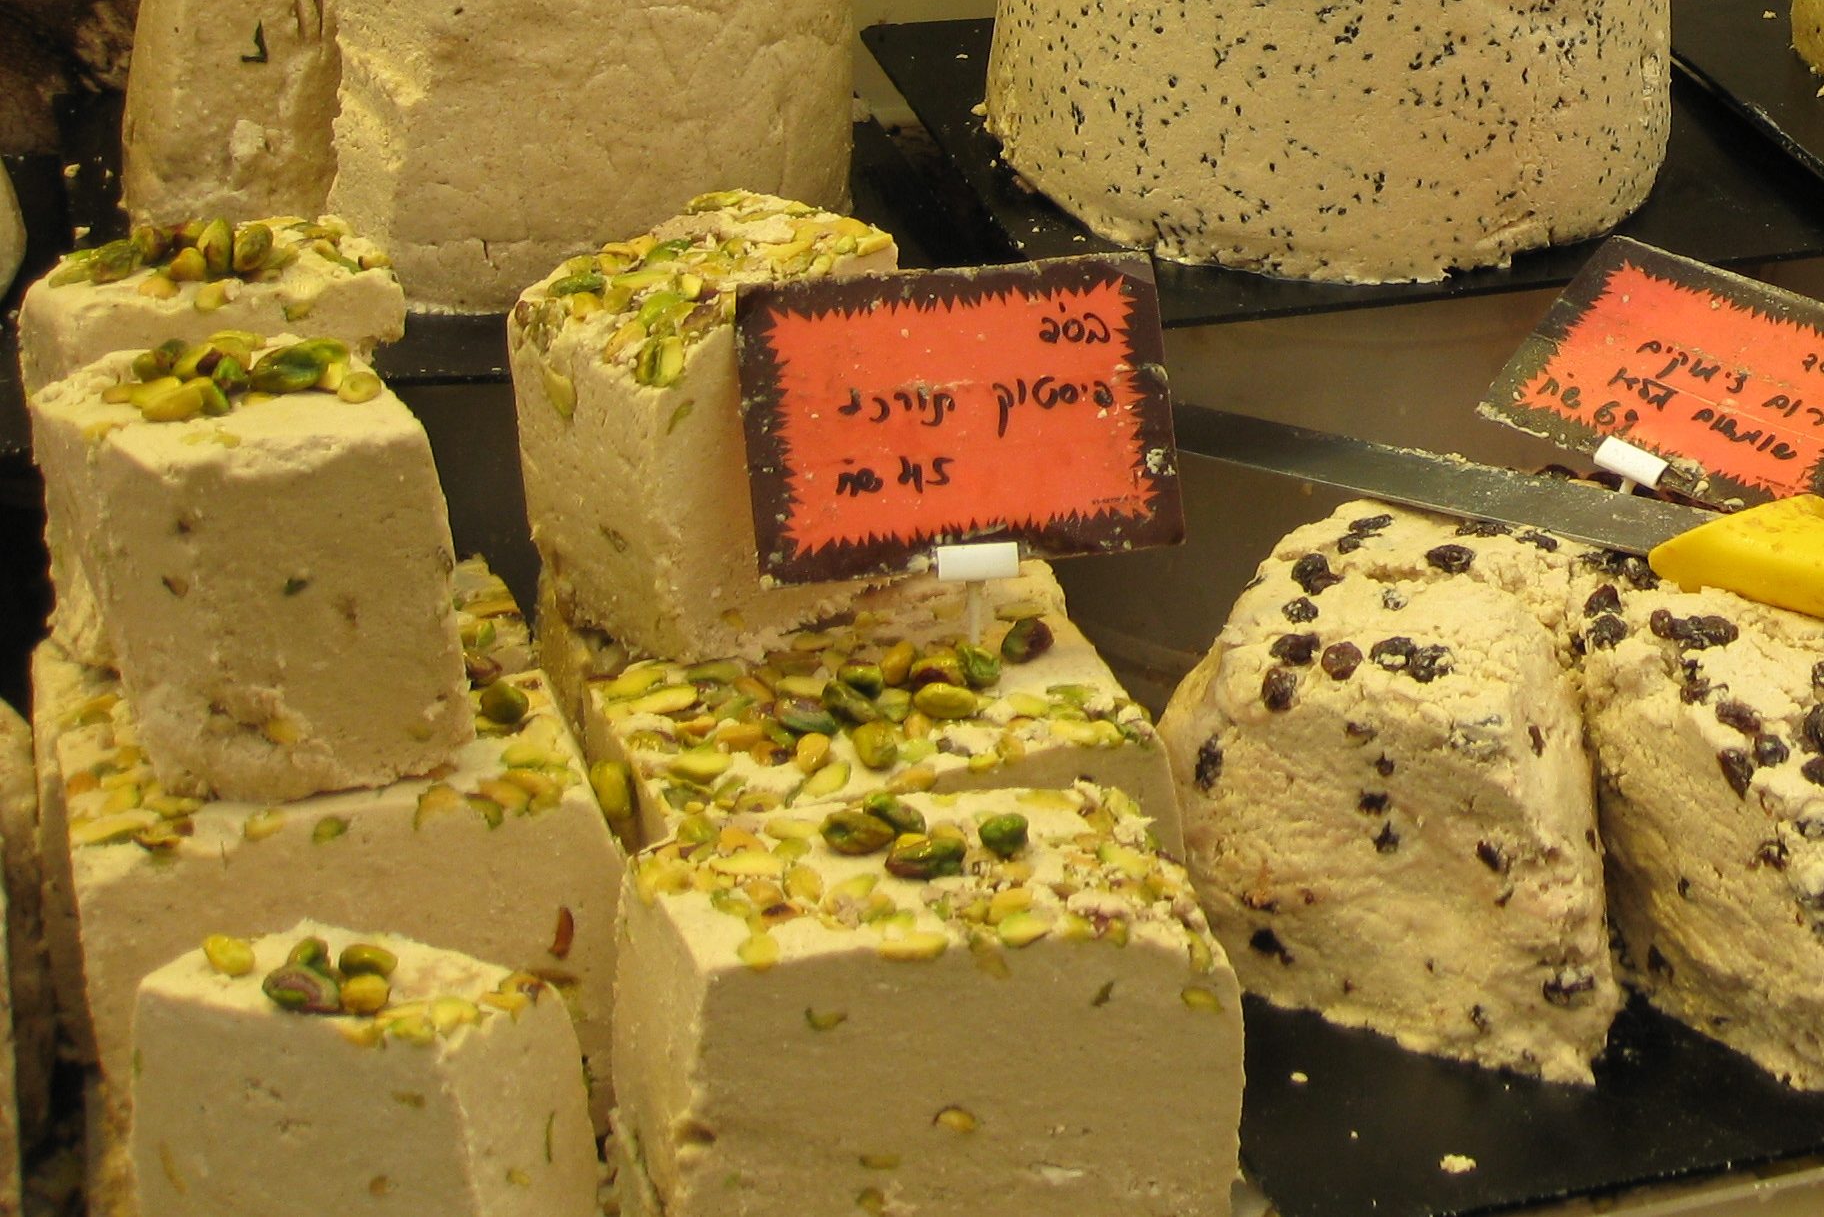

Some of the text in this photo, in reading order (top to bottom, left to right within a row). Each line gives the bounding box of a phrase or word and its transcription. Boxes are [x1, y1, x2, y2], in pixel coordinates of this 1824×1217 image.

[1636, 339, 1749, 394] צימוקים
[992, 375, 1115, 438] פיסטוק
[1593, 400, 1640, 435] 69
[1607, 367, 1799, 461] שומשום מלא
[897, 456, 956, 495] 45
